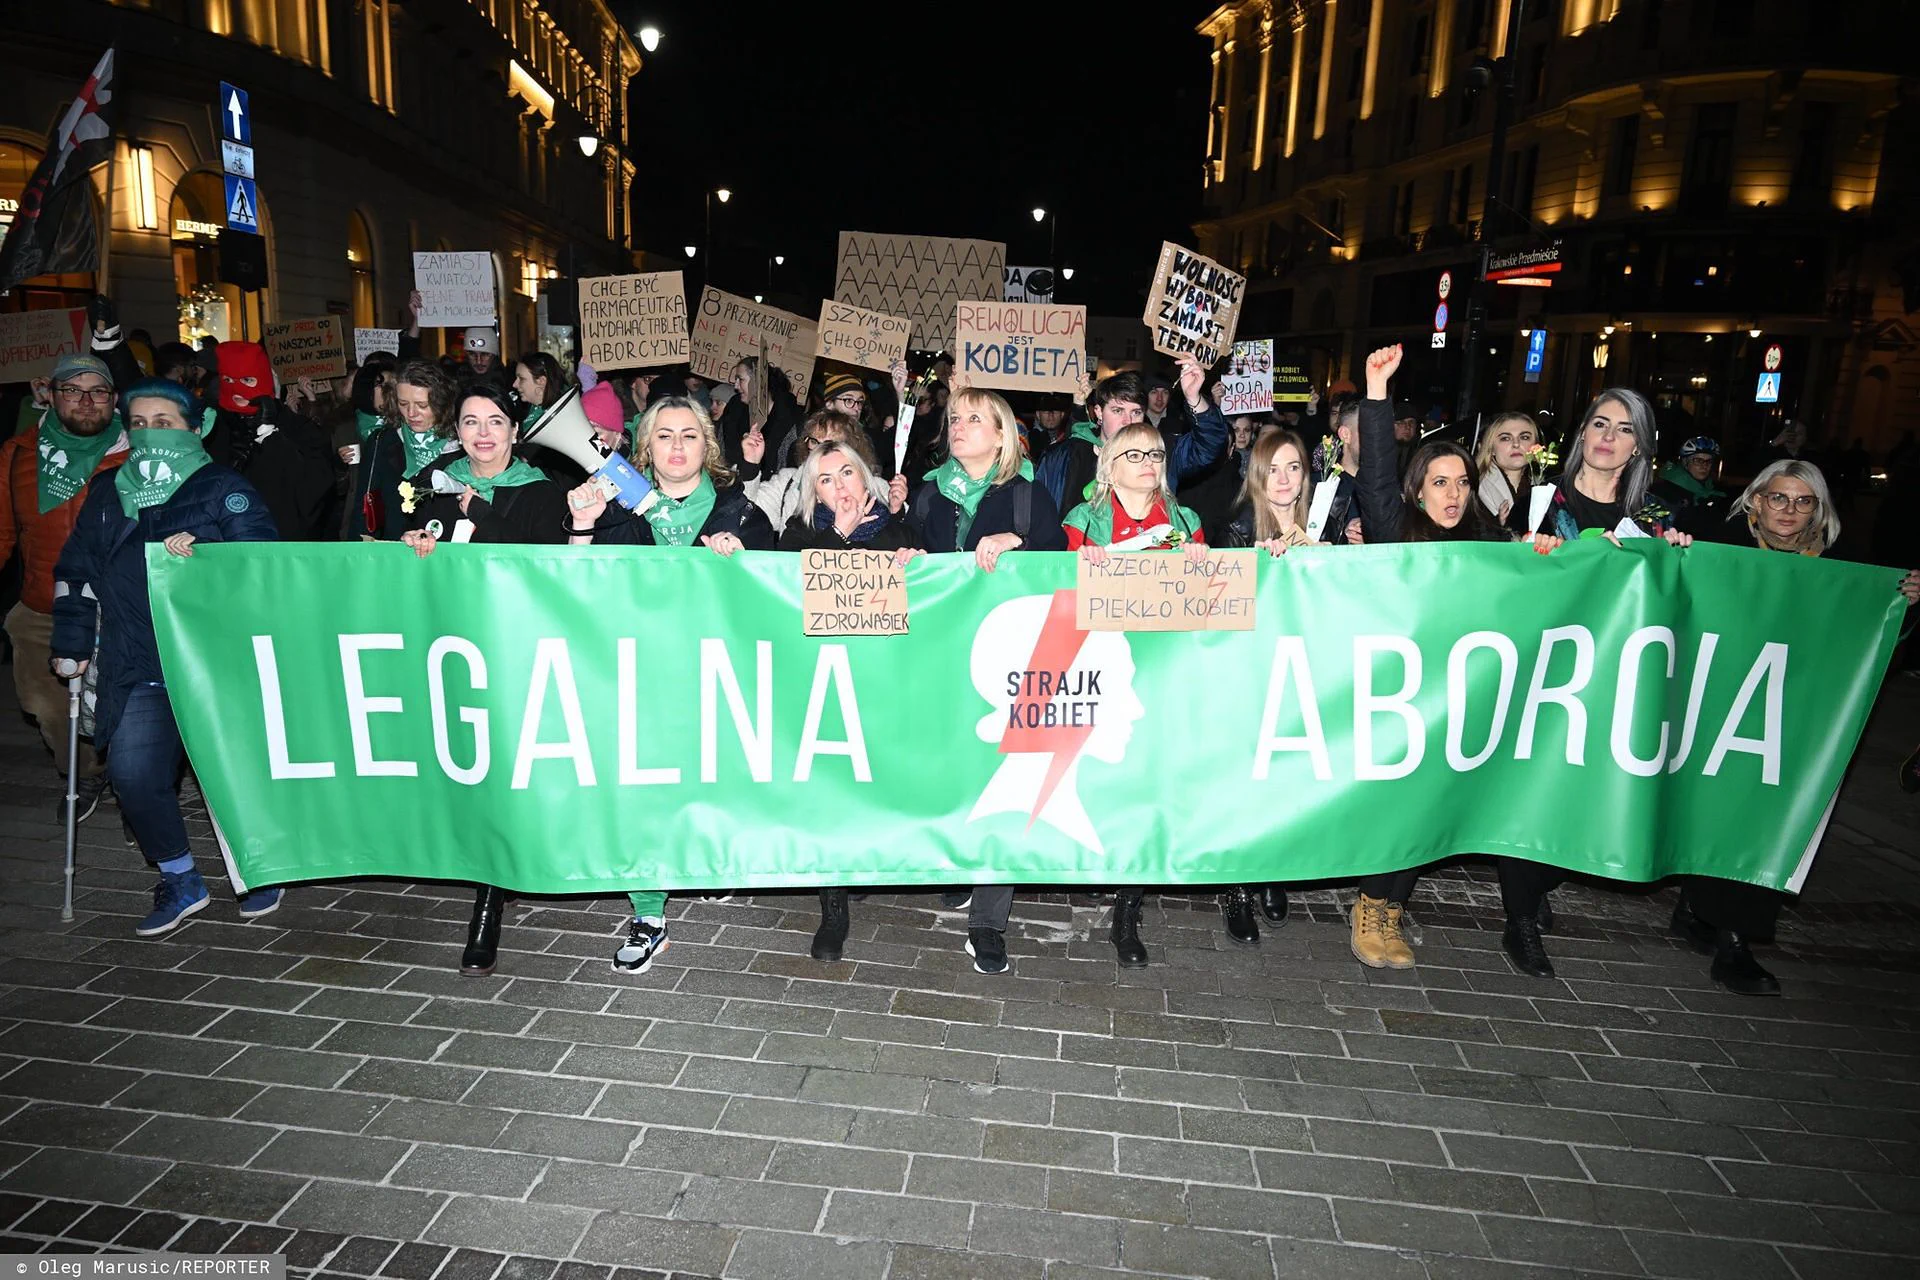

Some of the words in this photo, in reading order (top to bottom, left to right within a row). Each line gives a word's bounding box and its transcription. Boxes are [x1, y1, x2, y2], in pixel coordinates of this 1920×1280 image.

[418, 253, 488, 270] ZAMIAST
[1518, 246, 1559, 264] Przedmieście
[634, 273, 660, 295] BYĆ
[1172, 250, 1245, 304] WOLNOŚĆ
[583, 294, 687, 319] FARMACEUTKA
[703, 289, 722, 317] 8
[1164, 276, 1220, 315] WYBORU
[266, 324, 290, 336] ŁAPY
[318, 320, 330, 329] OD
[589, 317, 646, 339] WYDAWAĆ
[826, 304, 907, 334] SZYMON
[958, 305, 1087, 337] REWOLUCJA
[1158, 300, 1225, 344] ZAMIAST
[279, 336, 322, 351] NASZYCH
[589, 338, 689, 363] ABORCYJNE
[823, 329, 902, 358] CHŁODNIA
[1007, 335, 1035, 346] JEST
[1157, 324, 1219, 366] TERRORU
[1281, 366, 1300, 374] KOBIET
[1529, 353, 1541, 370] P
[1224, 380, 1263, 395] MOJA
[1279, 375, 1309, 383] CZŁOWIEKA
[1224, 389, 1274, 412] SPRAWA
[808, 550, 896, 570] CHCEMY
[1183, 558, 1244, 578] DROGA
[804, 572, 904, 592] ZDROWIA
[1159, 579, 1187, 595] TO
[835, 593, 865, 609] NIE
[1089, 597, 1173, 620] PIEKŁO
[1183, 596, 1256, 618] KOBIET
[1006, 670, 1102, 697] STRAJK
[251, 633, 874, 790] LEGALNA
[1251, 624, 1789, 786] ABORCJA
[1009, 701, 1099, 729] KOBIET
